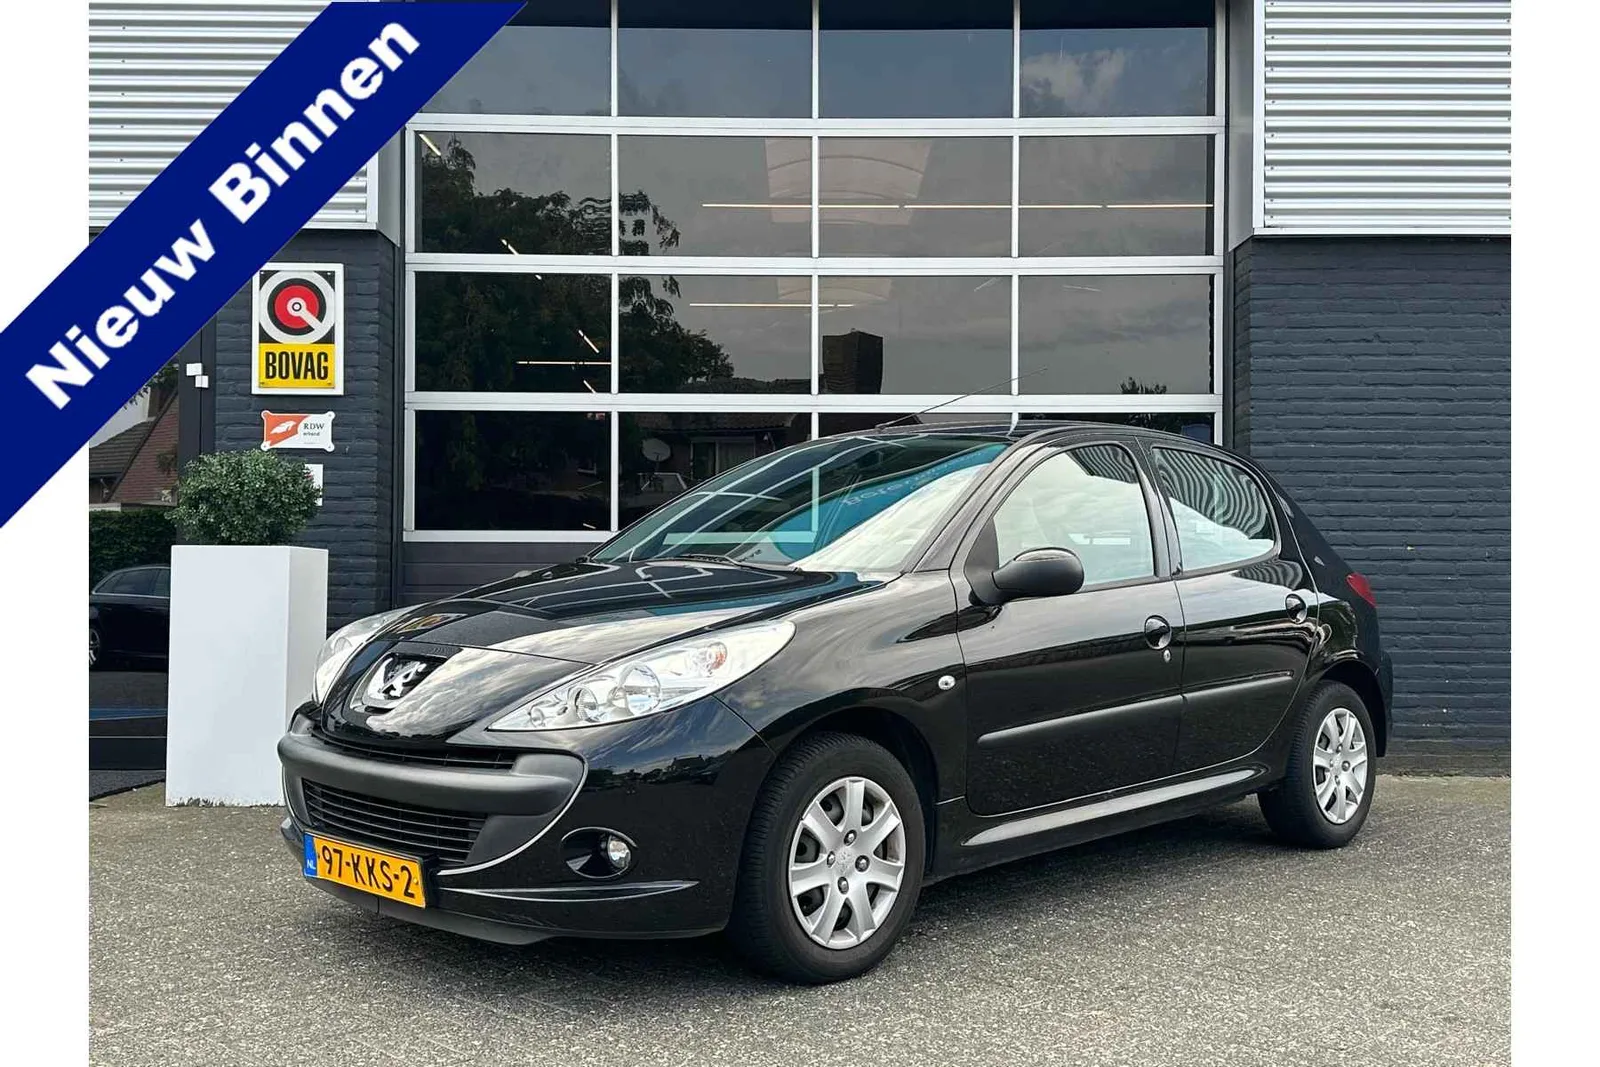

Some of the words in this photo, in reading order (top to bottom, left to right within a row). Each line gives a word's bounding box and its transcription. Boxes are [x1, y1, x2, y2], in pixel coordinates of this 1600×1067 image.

[265, 351, 328, 380] BOVAG
[303, 422, 325, 430] RDW
[306, 859, 316, 870] NL
[322, 845, 415, 899] 97-KKS-2
